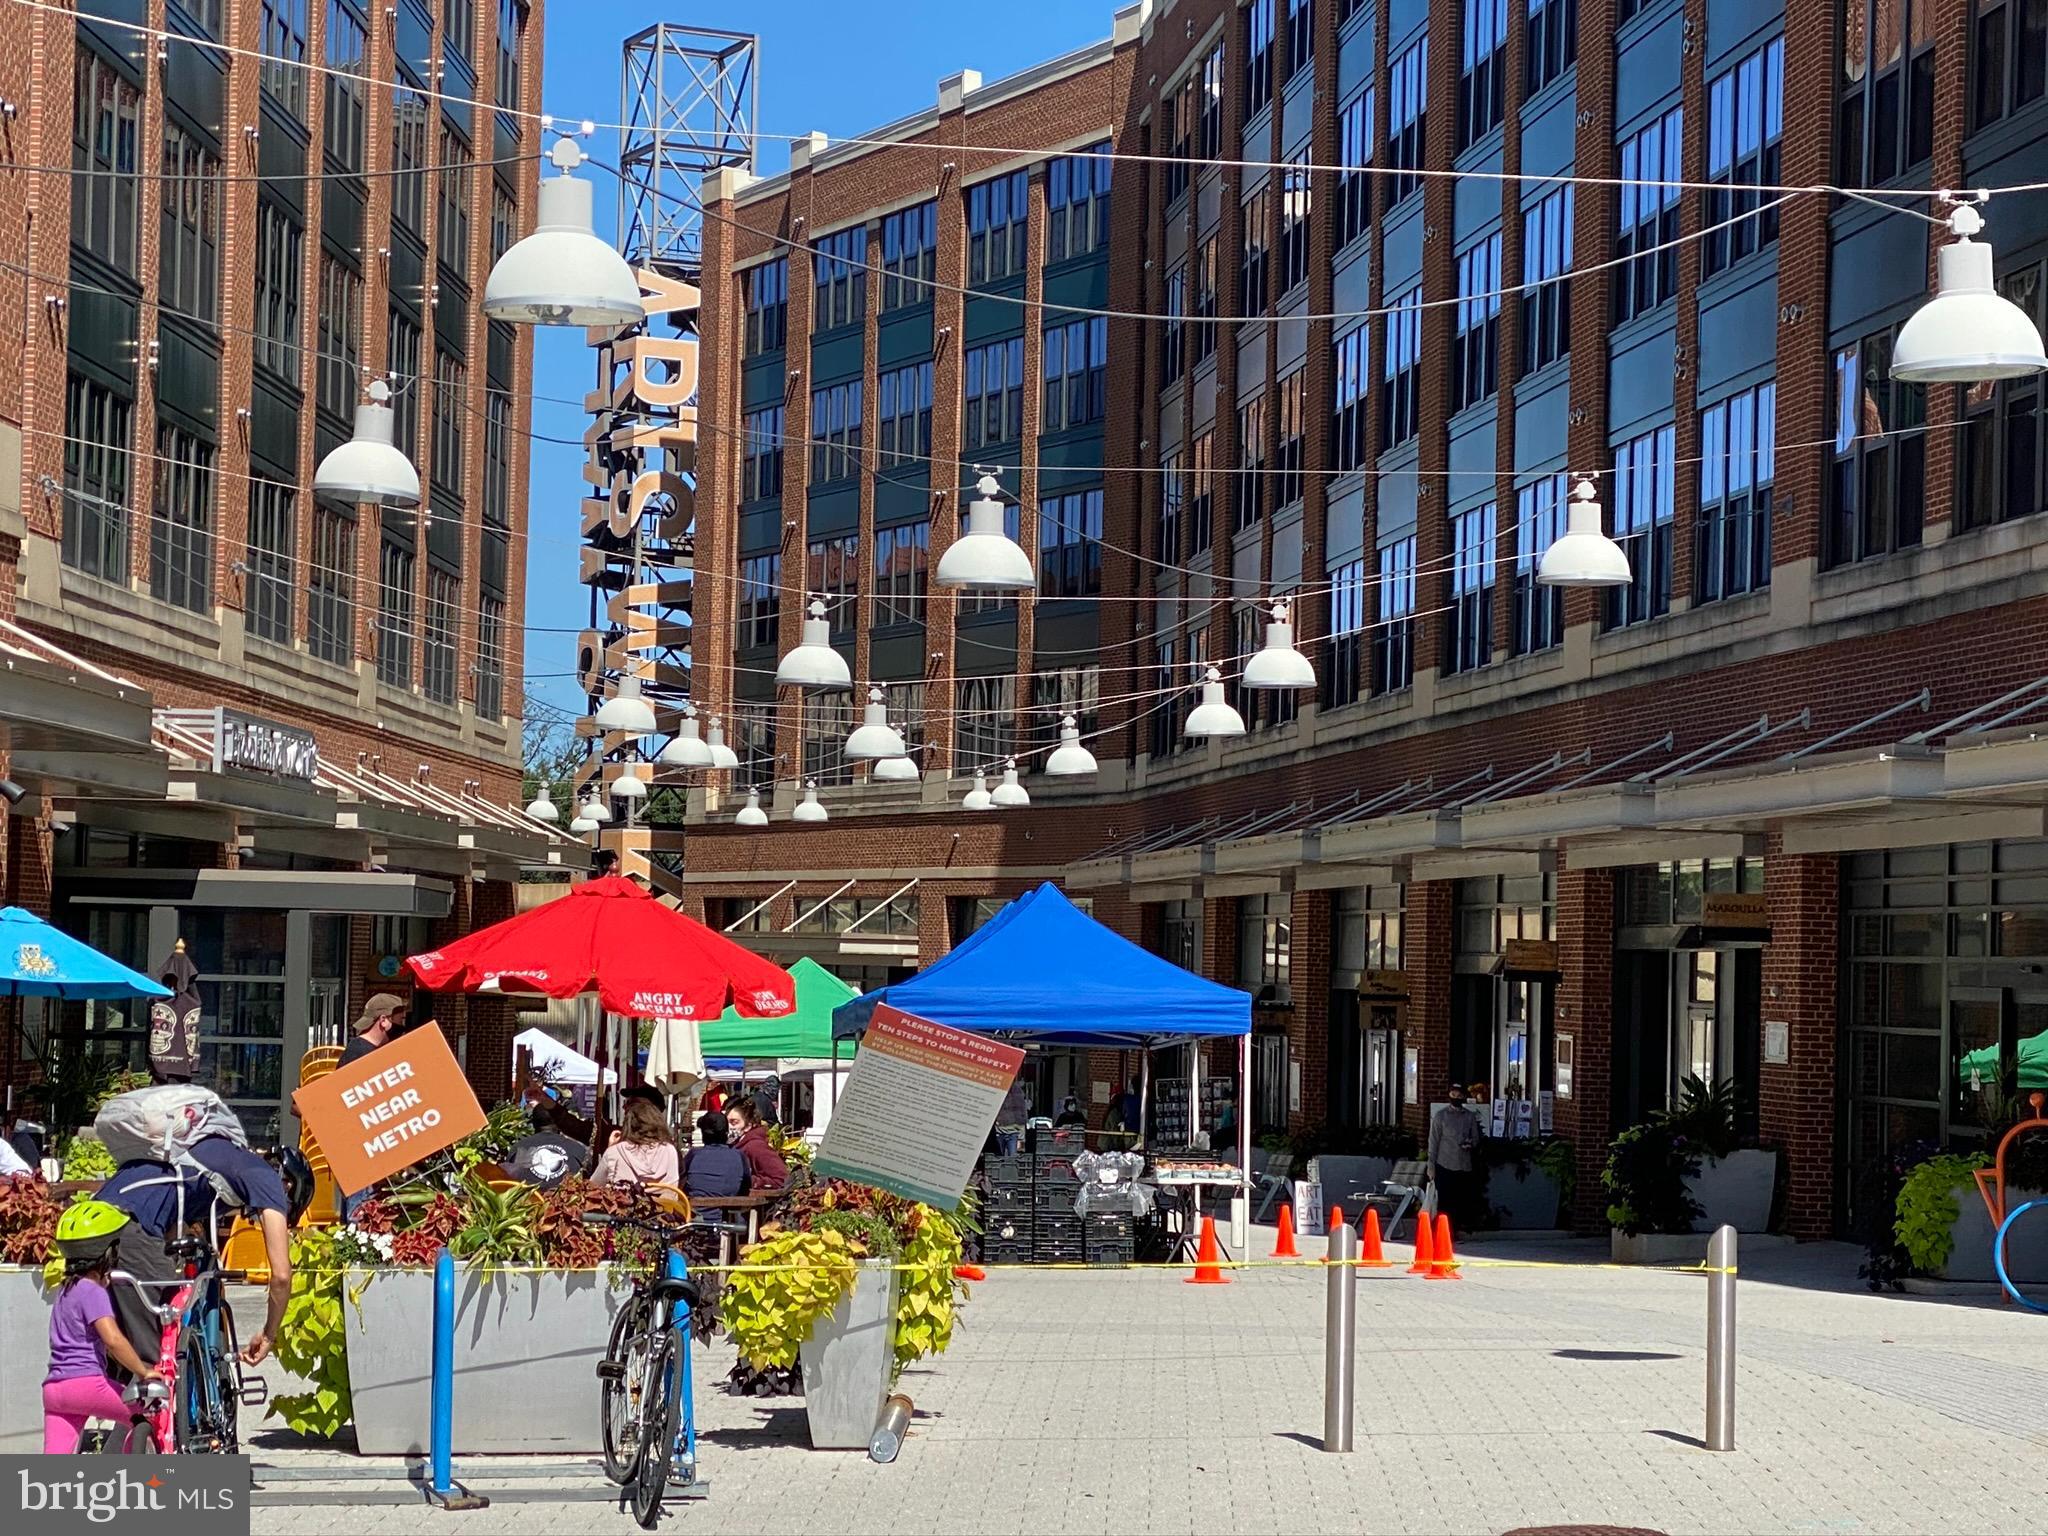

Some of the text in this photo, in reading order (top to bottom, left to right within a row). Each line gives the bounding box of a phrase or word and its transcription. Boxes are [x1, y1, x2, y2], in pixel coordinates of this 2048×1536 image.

[608, 268, 702, 540] ARTS
[629, 1000, 695, 1016] ORCHARD
[633, 992, 684, 1006] ANGRY
[877, 1022, 1012, 1071] TEN STEPS TO MARKET SAFETY
[901, 1018, 934, 1035] PLEASE
[935, 1029, 960, 1042] STOP
[968, 1040, 997, 1054] READ!
[340, 1061, 415, 1109] ENTER
[359, 1088, 422, 1130] NEAR
[363, 1108, 441, 1159] METRO
[1298, 1185, 1321, 1200] ART
[1298, 1206, 1321, 1221] EAT
